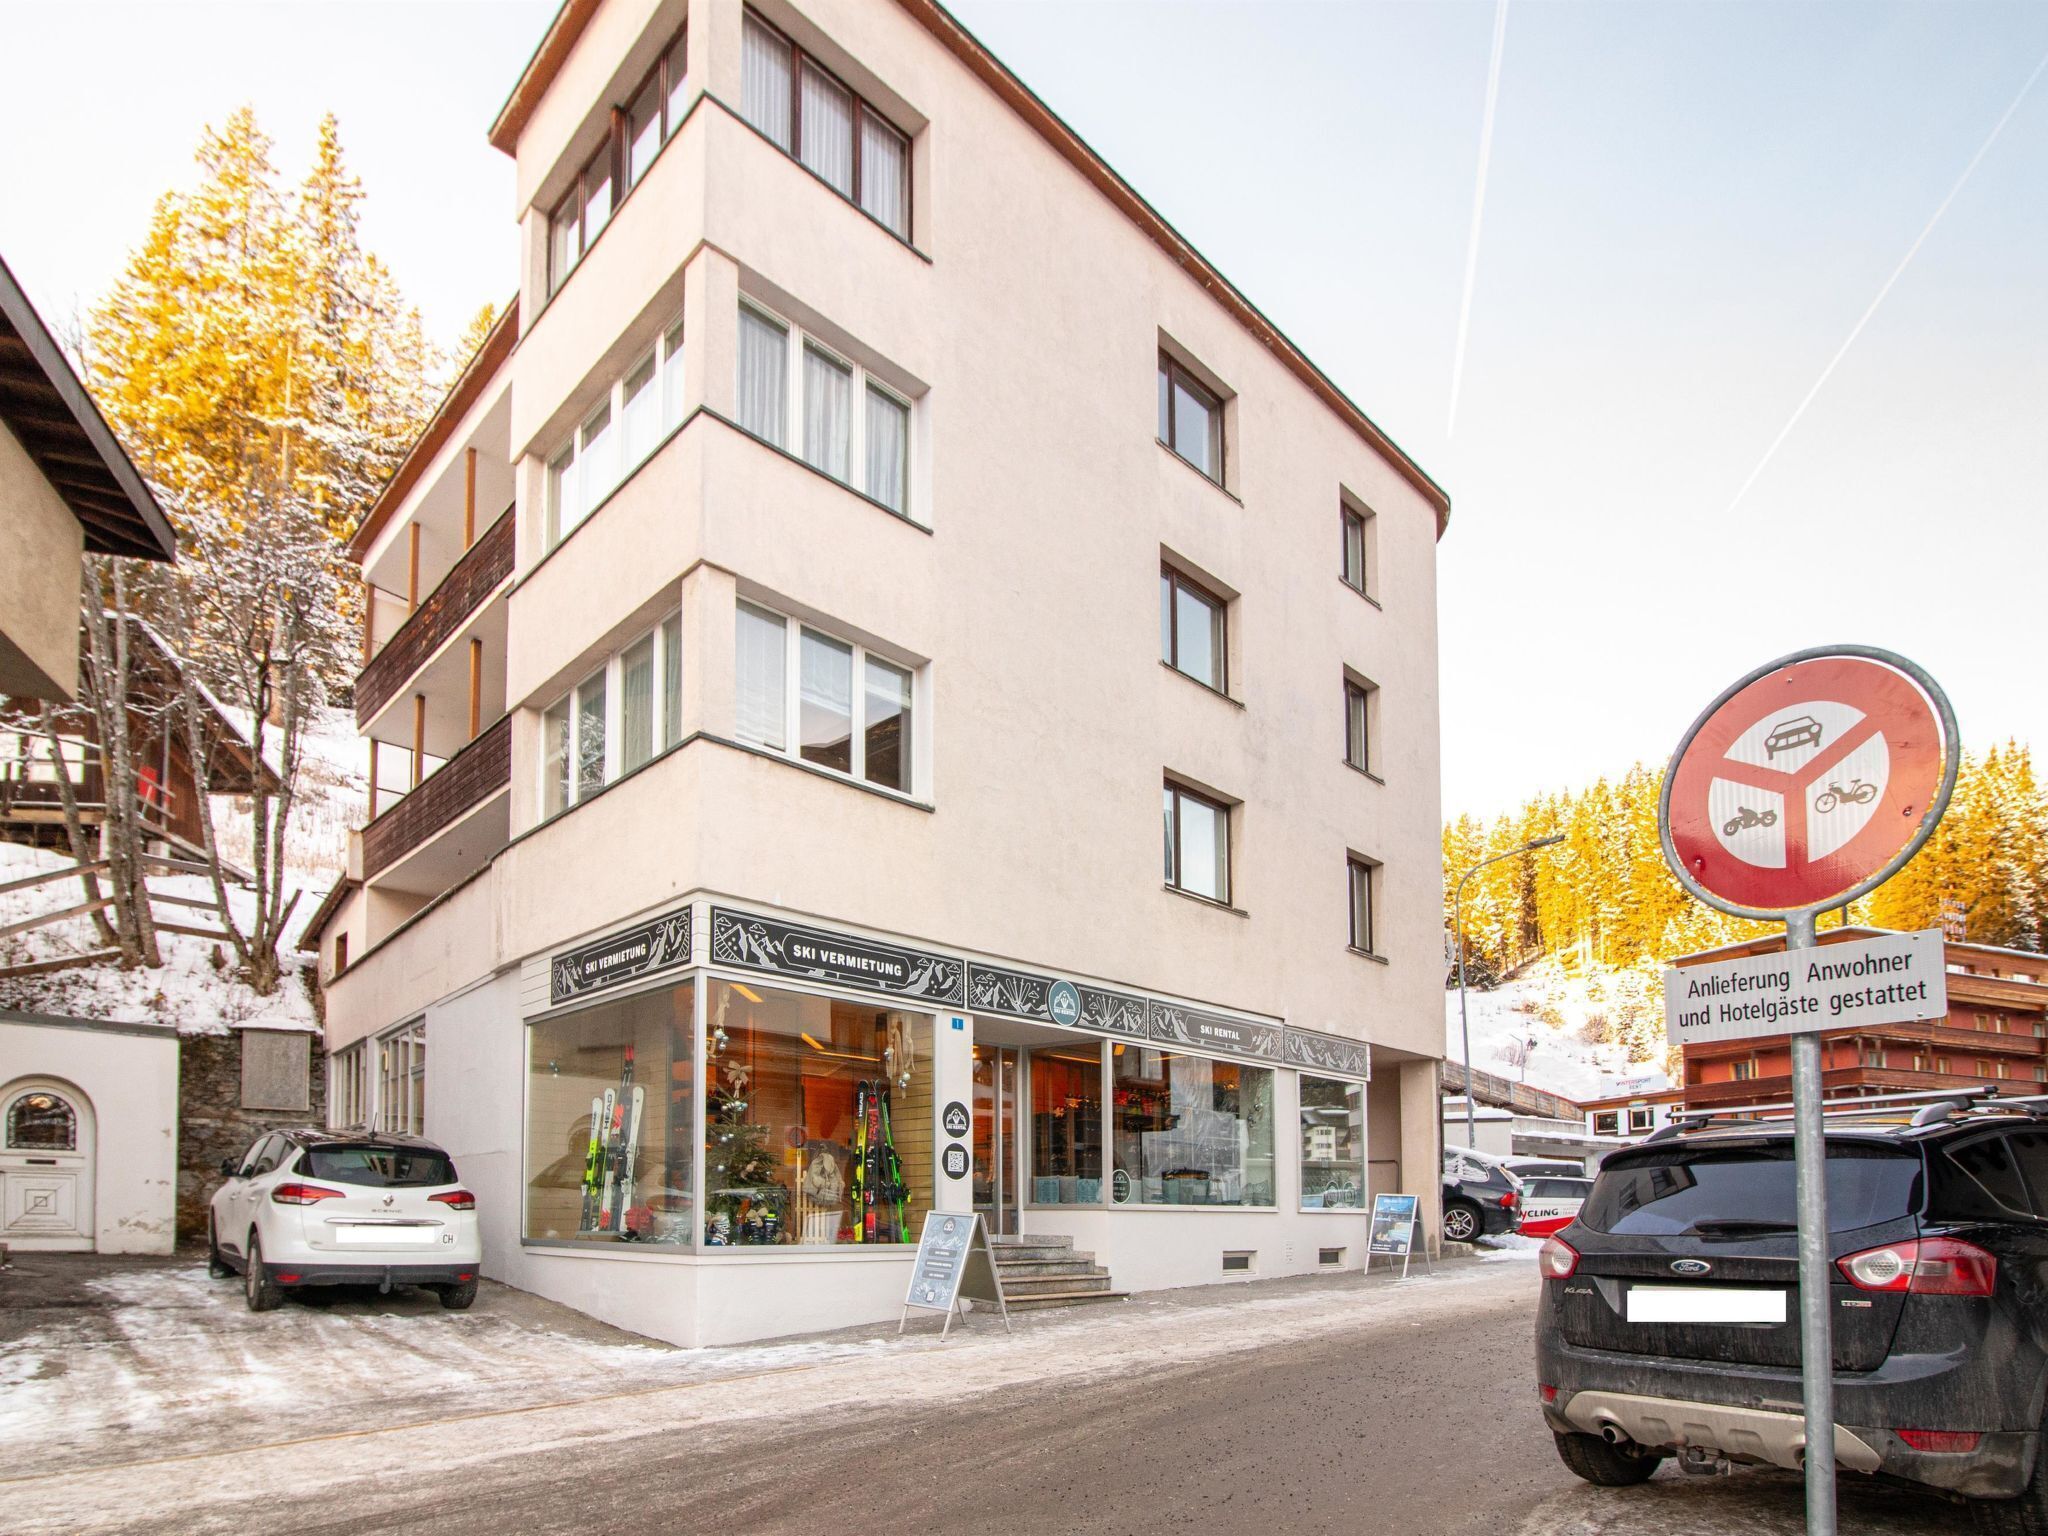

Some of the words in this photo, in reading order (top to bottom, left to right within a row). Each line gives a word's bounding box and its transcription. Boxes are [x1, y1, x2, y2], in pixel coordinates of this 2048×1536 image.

[585, 960, 597, 974] SKI
[599, 943, 646, 970] VERMIETUNG
[793, 944, 816, 960] SKI
[820, 950, 902, 976] VERMIETUNG
[1688, 971, 1790, 999] Anlieferung
[1807, 953, 1912, 983] Anwohner
[1679, 1005, 1710, 1027] und
[1720, 996, 1818, 1023] Hotelgäste
[1830, 980, 1927, 1015] gestattet
[1200, 1024, 1212, 1035] SKI
[1214, 1027, 1240, 1040] RENTAL
[603, 1094, 613, 1130] HEAD
[1519, 1208, 1559, 1221] YCLING
[443, 1234, 454, 1244] CH
[1678, 1261, 1700, 1272] Ford
